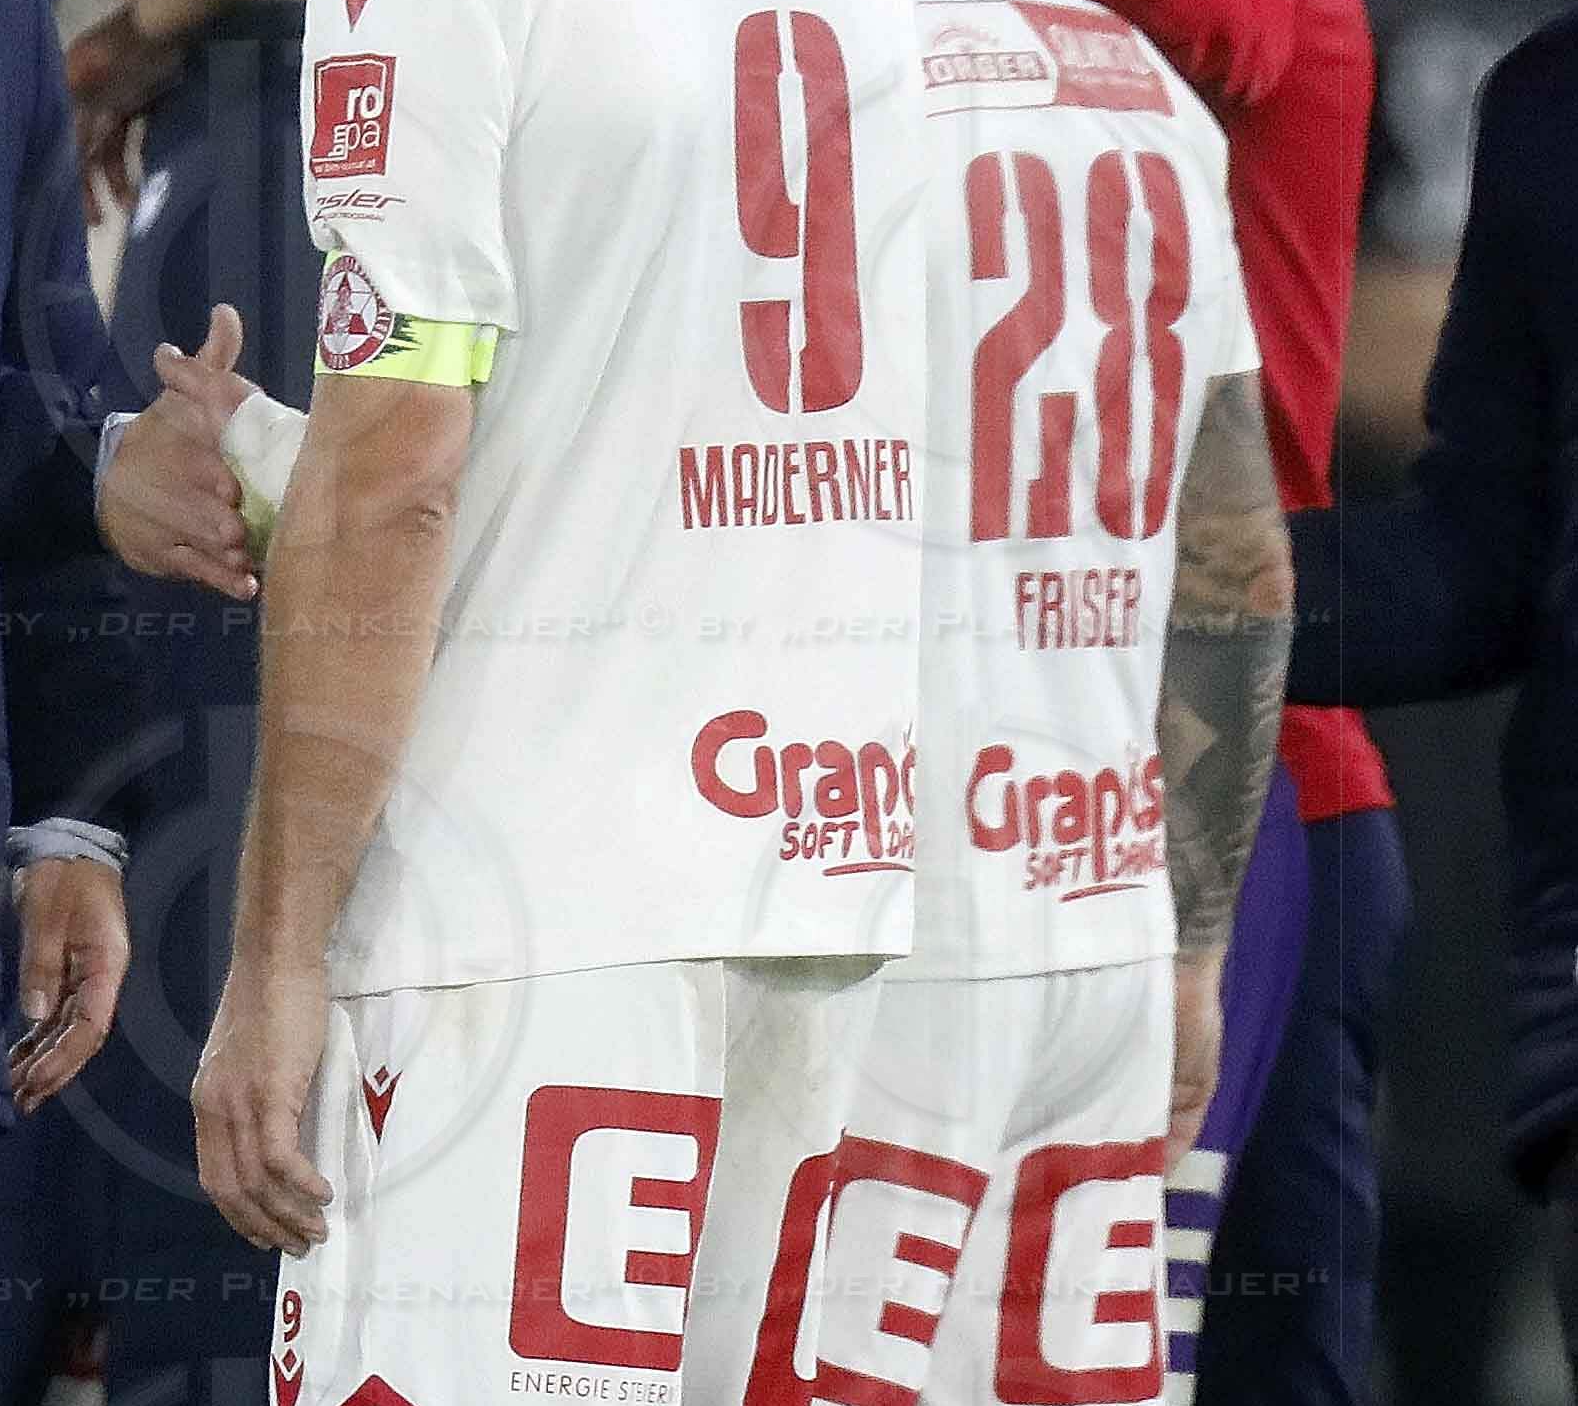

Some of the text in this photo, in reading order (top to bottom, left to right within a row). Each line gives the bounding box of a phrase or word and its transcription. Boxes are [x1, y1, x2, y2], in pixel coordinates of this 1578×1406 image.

[733, 8, 865, 415] 9
[964, 148, 1192, 543] 28
[679, 439, 913, 529] MADERNER
[1015, 568, 1142, 650] FRISER
[779, 820, 860, 861] SOFT
[281, 1289, 303, 1342] 9
[510, 1371, 612, 1399] ENERGIE
